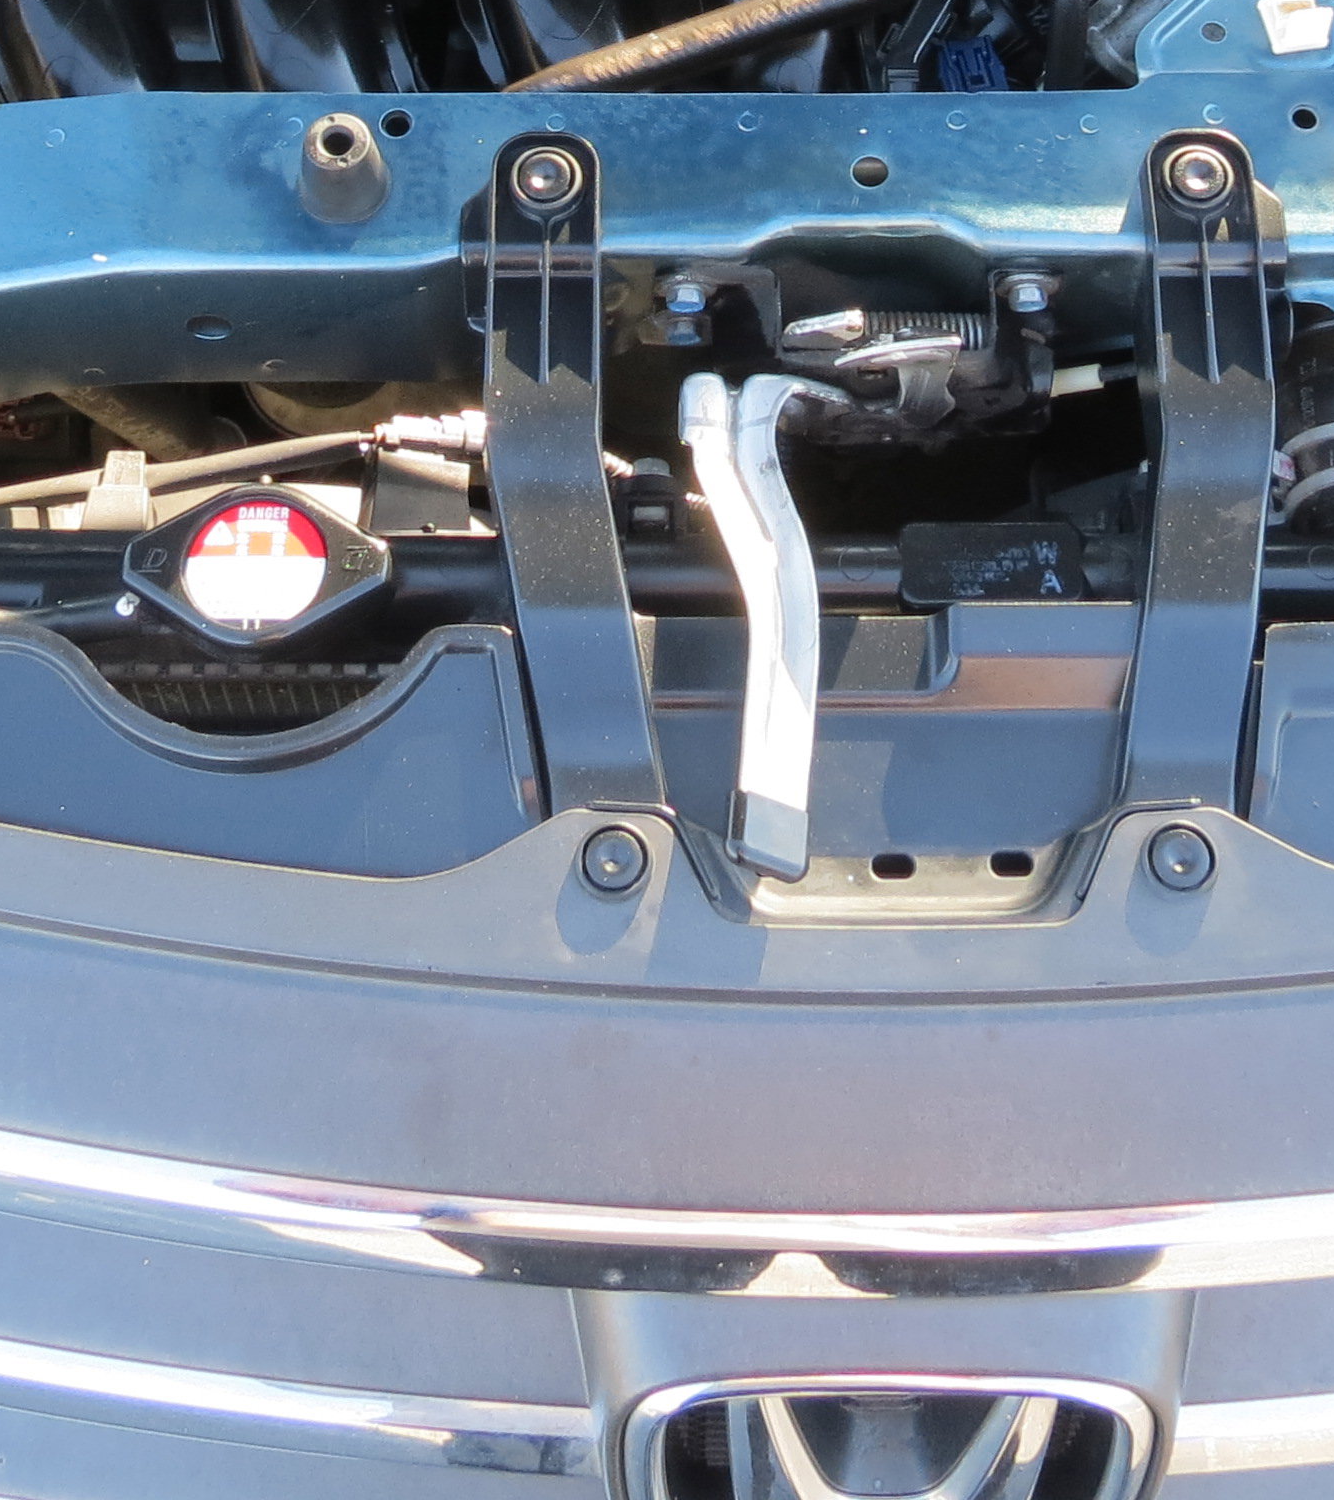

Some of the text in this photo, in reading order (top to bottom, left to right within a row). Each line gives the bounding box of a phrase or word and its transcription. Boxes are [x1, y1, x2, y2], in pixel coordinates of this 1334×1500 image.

[238, 506, 290, 519] DANGER
[1034, 540, 1058, 565] W
[1039, 569, 1063, 595] A
